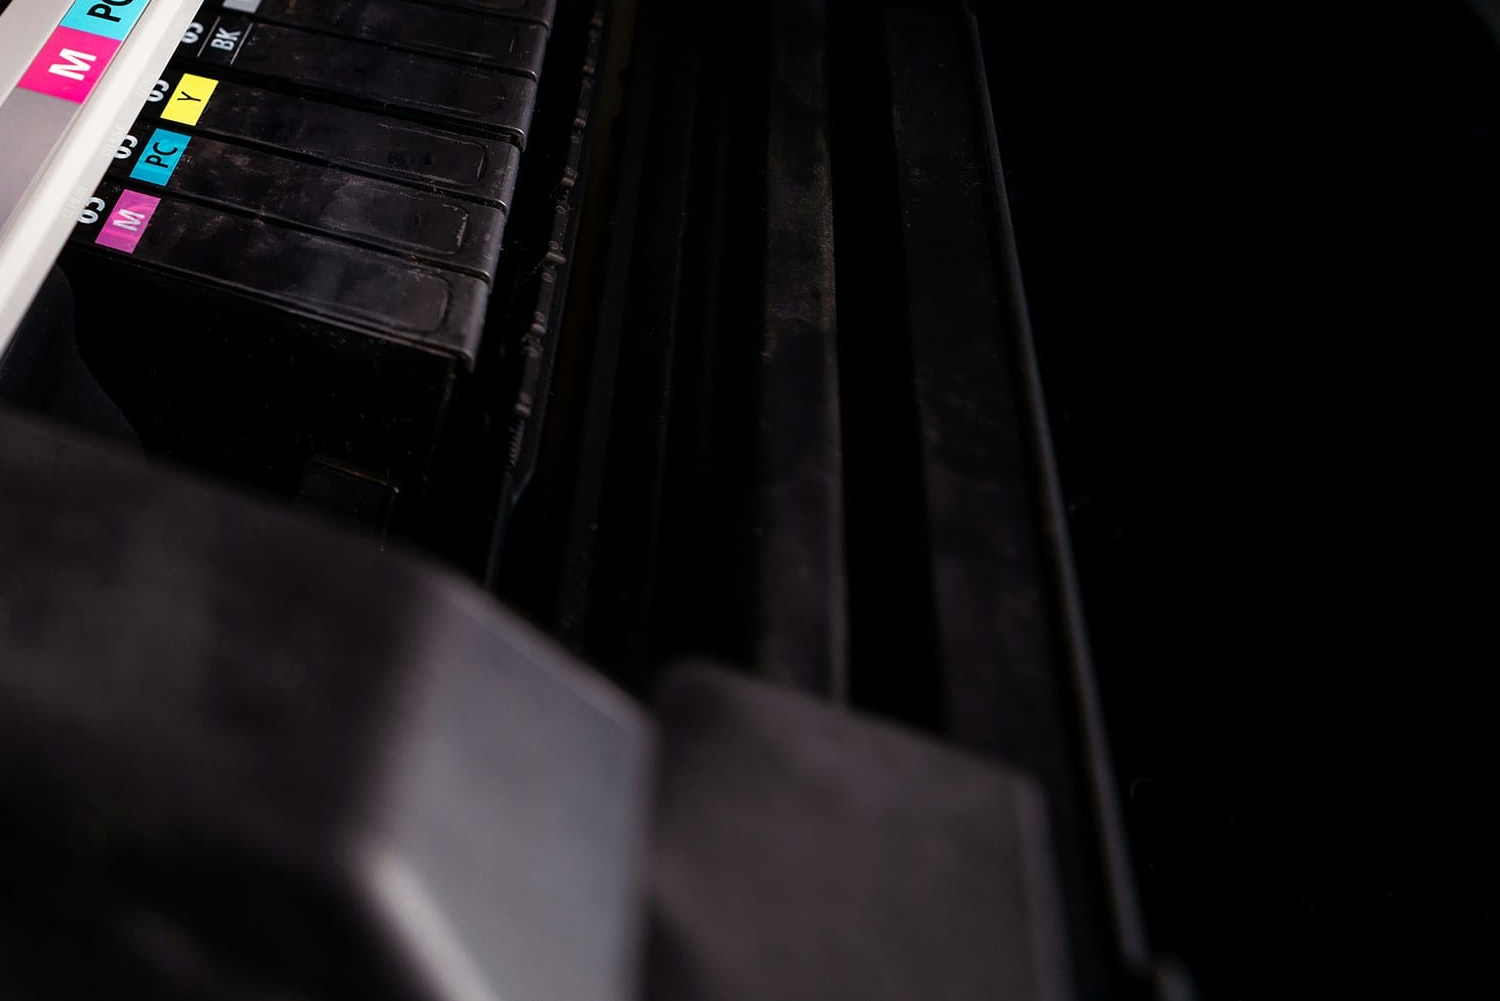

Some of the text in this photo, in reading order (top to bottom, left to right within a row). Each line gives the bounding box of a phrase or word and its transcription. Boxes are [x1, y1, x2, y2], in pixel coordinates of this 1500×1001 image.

[210, 26, 241, 51] BK
[49, 48, 97, 81] M
[177, 91, 202, 102] Y
[145, 142, 179, 169] PC
[112, 208, 146, 232] M
